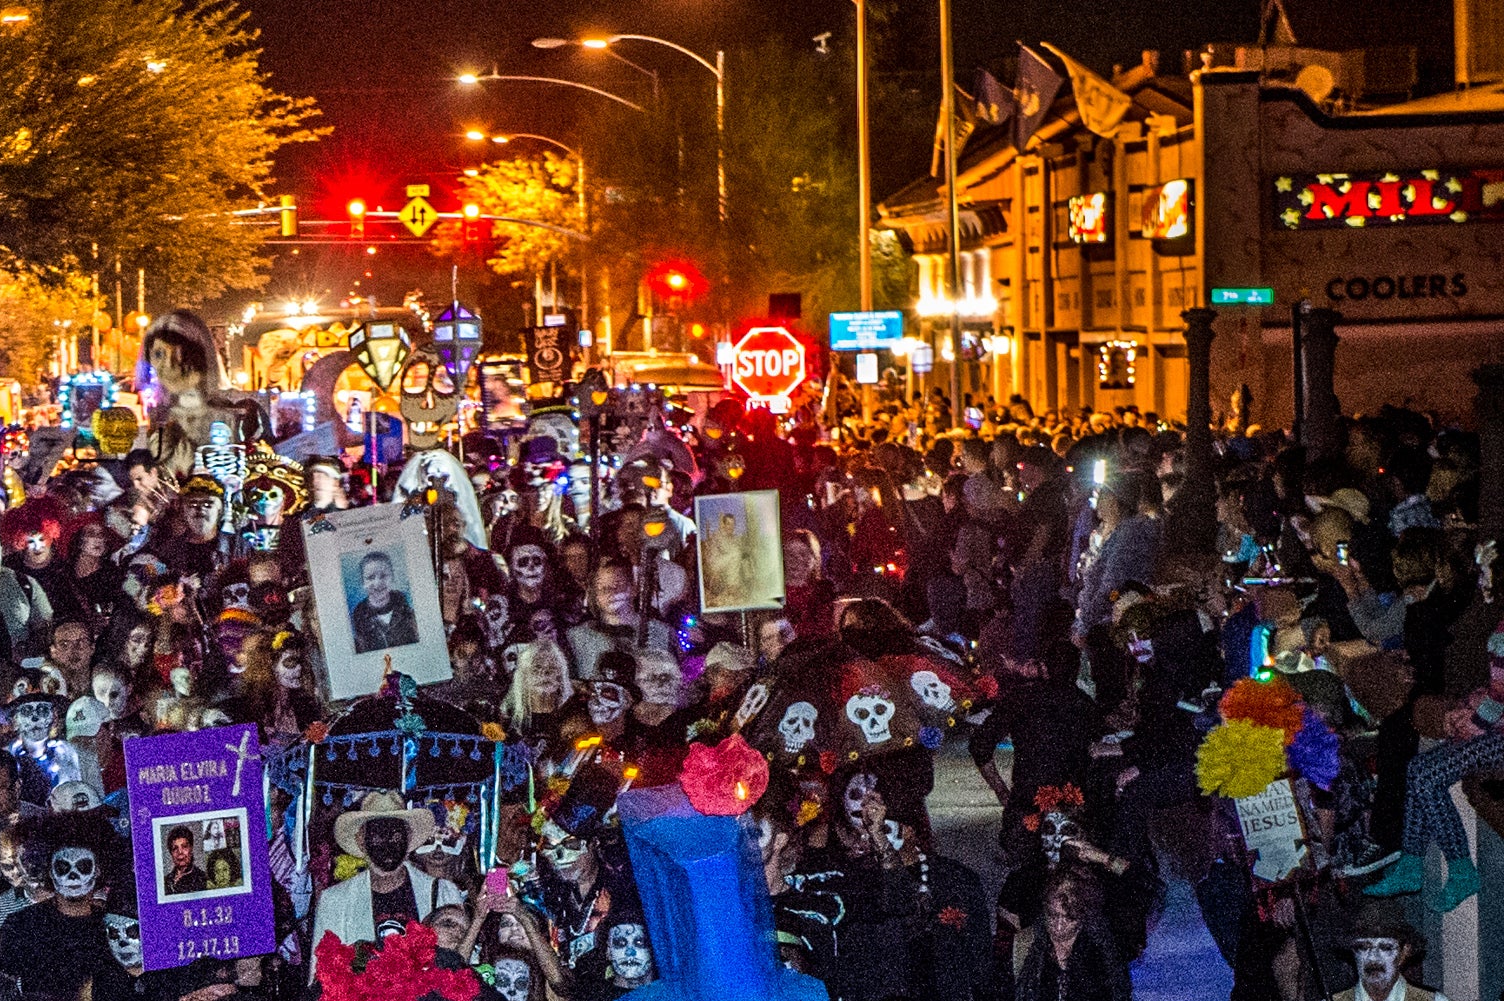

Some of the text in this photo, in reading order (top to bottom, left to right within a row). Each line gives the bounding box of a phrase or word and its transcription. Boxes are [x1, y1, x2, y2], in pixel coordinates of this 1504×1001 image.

[1325, 273, 1468, 300] COOLERS
[738, 349, 799, 377] STOP
[138, 760, 228, 785] MARIA ELVIRA
[1238, 796, 1294, 817] NAMED
[1243, 811, 1298, 835] JESUS
